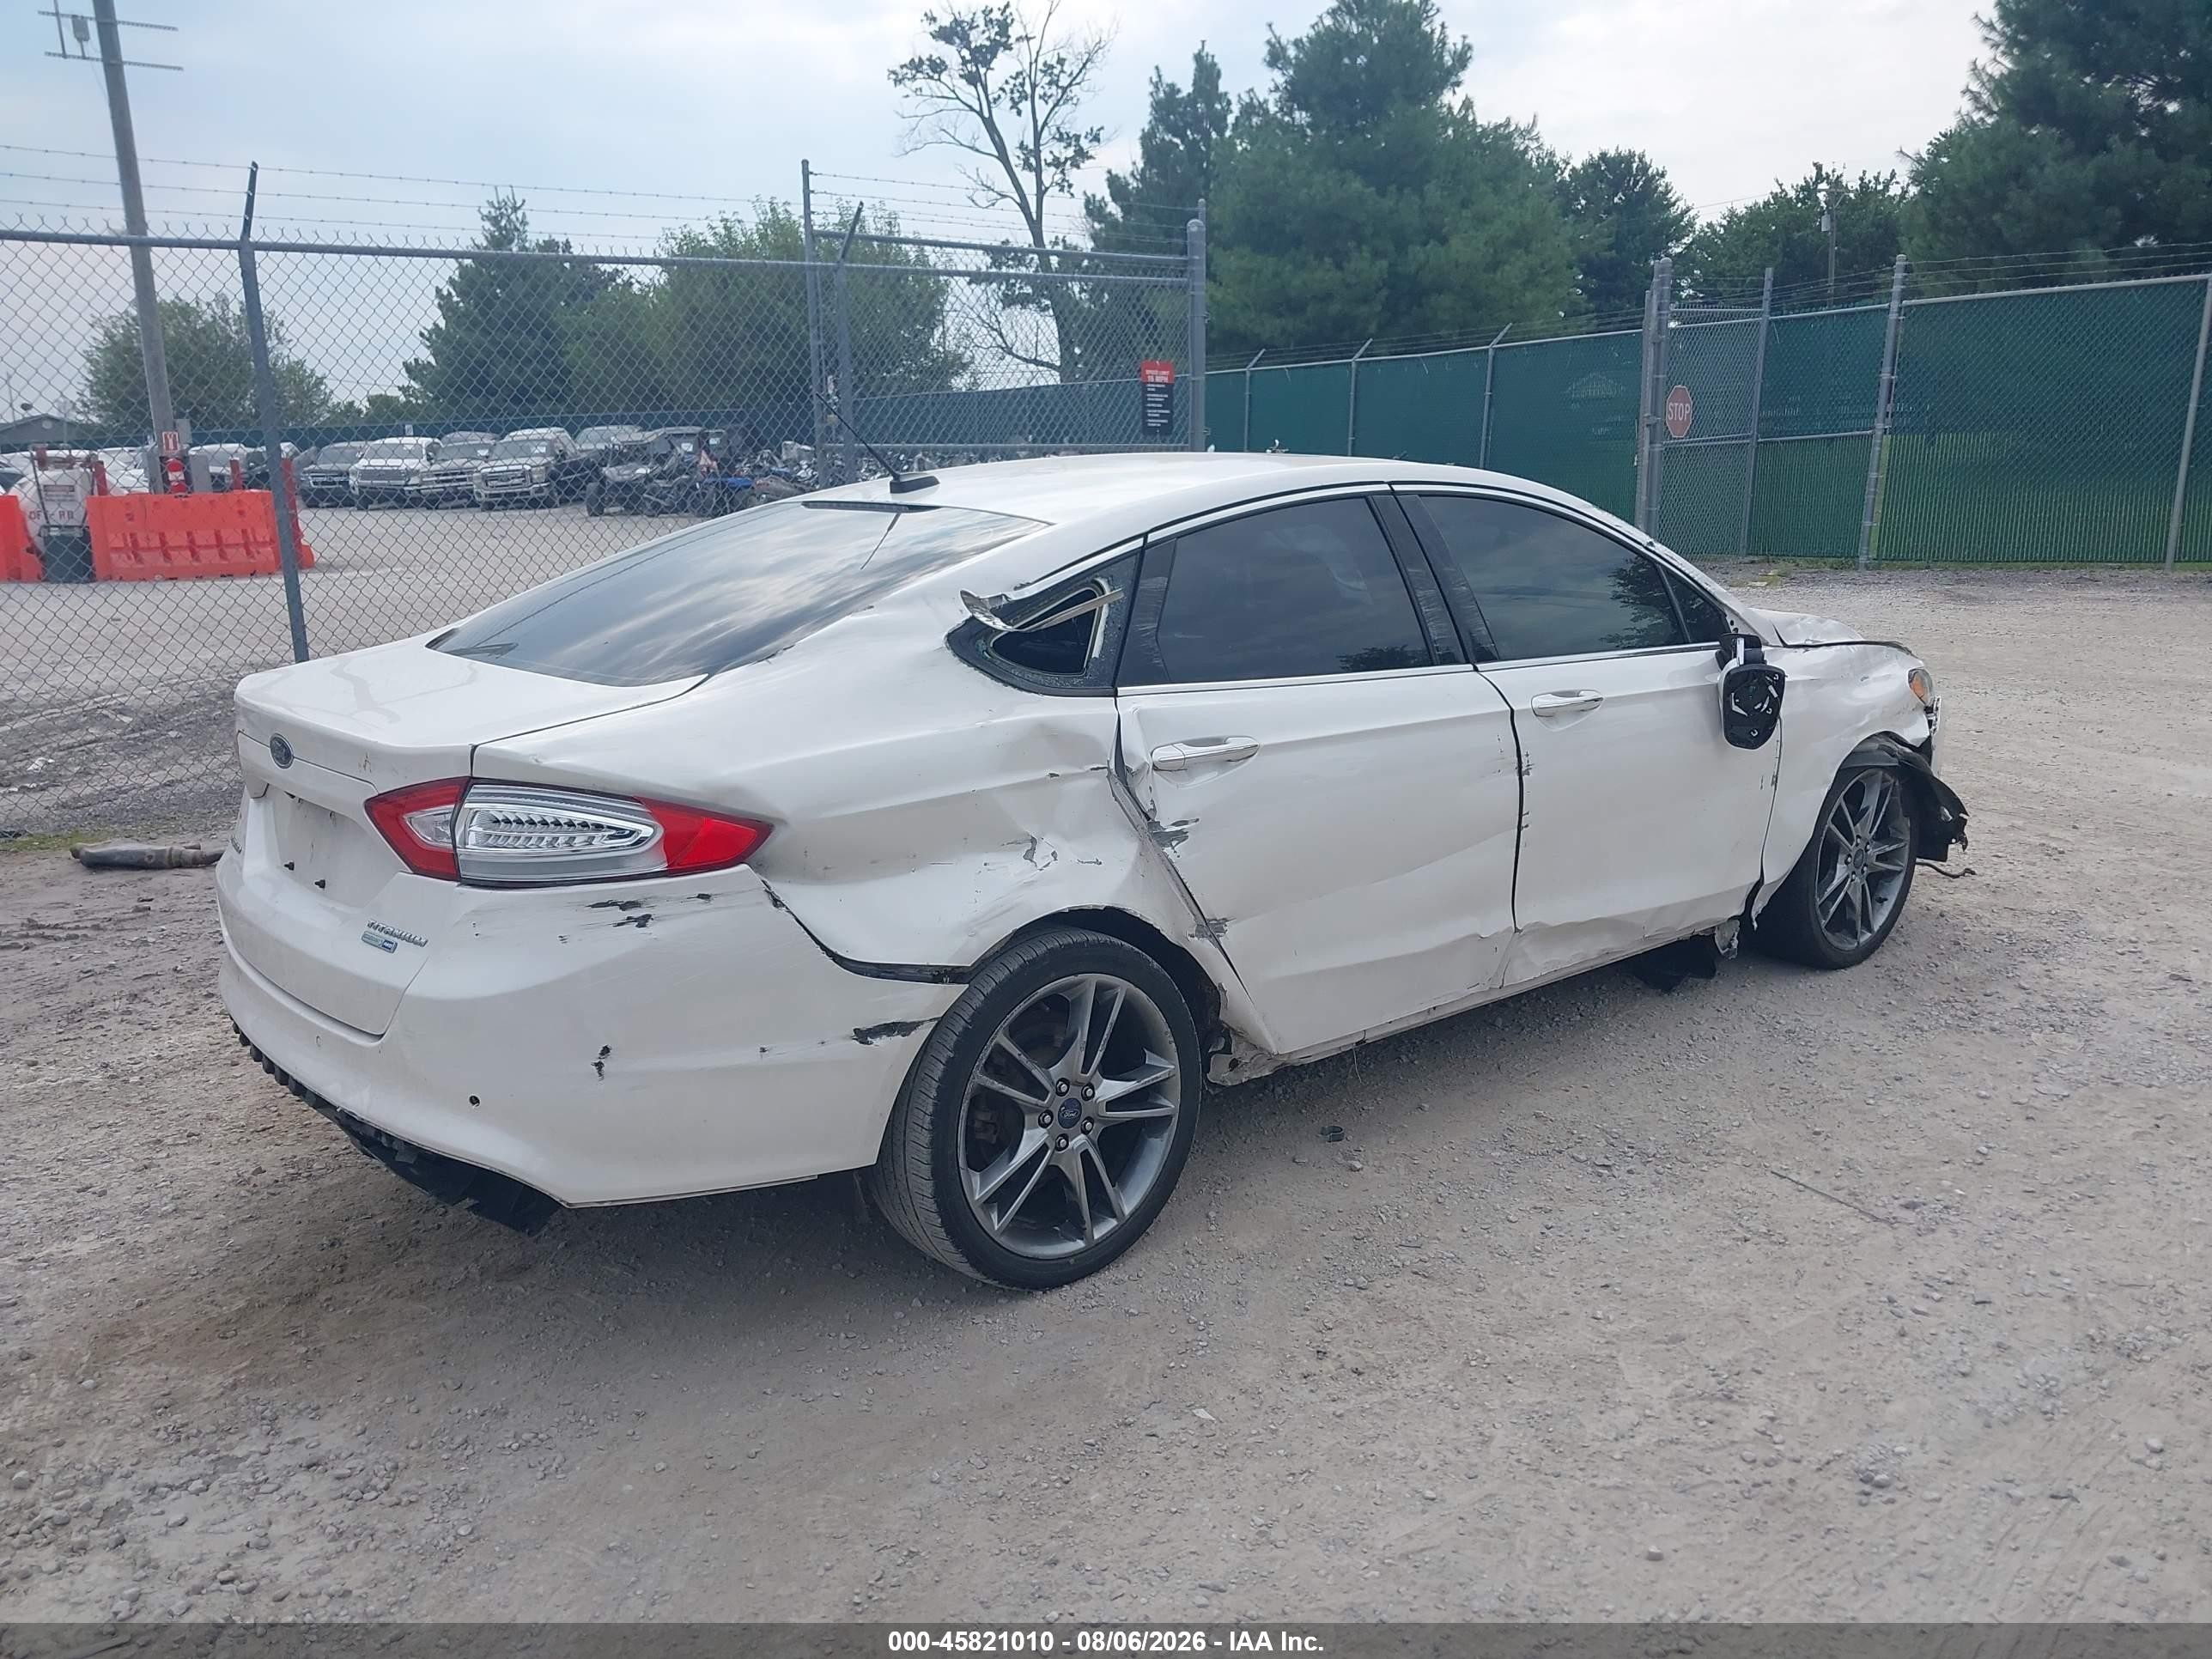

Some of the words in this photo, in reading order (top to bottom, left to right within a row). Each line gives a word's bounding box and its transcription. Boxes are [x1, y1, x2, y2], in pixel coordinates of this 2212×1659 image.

[1668, 403, 1691, 421] STOP
[367, 919, 428, 947] TITANIUM
[1061, 1109, 1079, 1118] Ford
